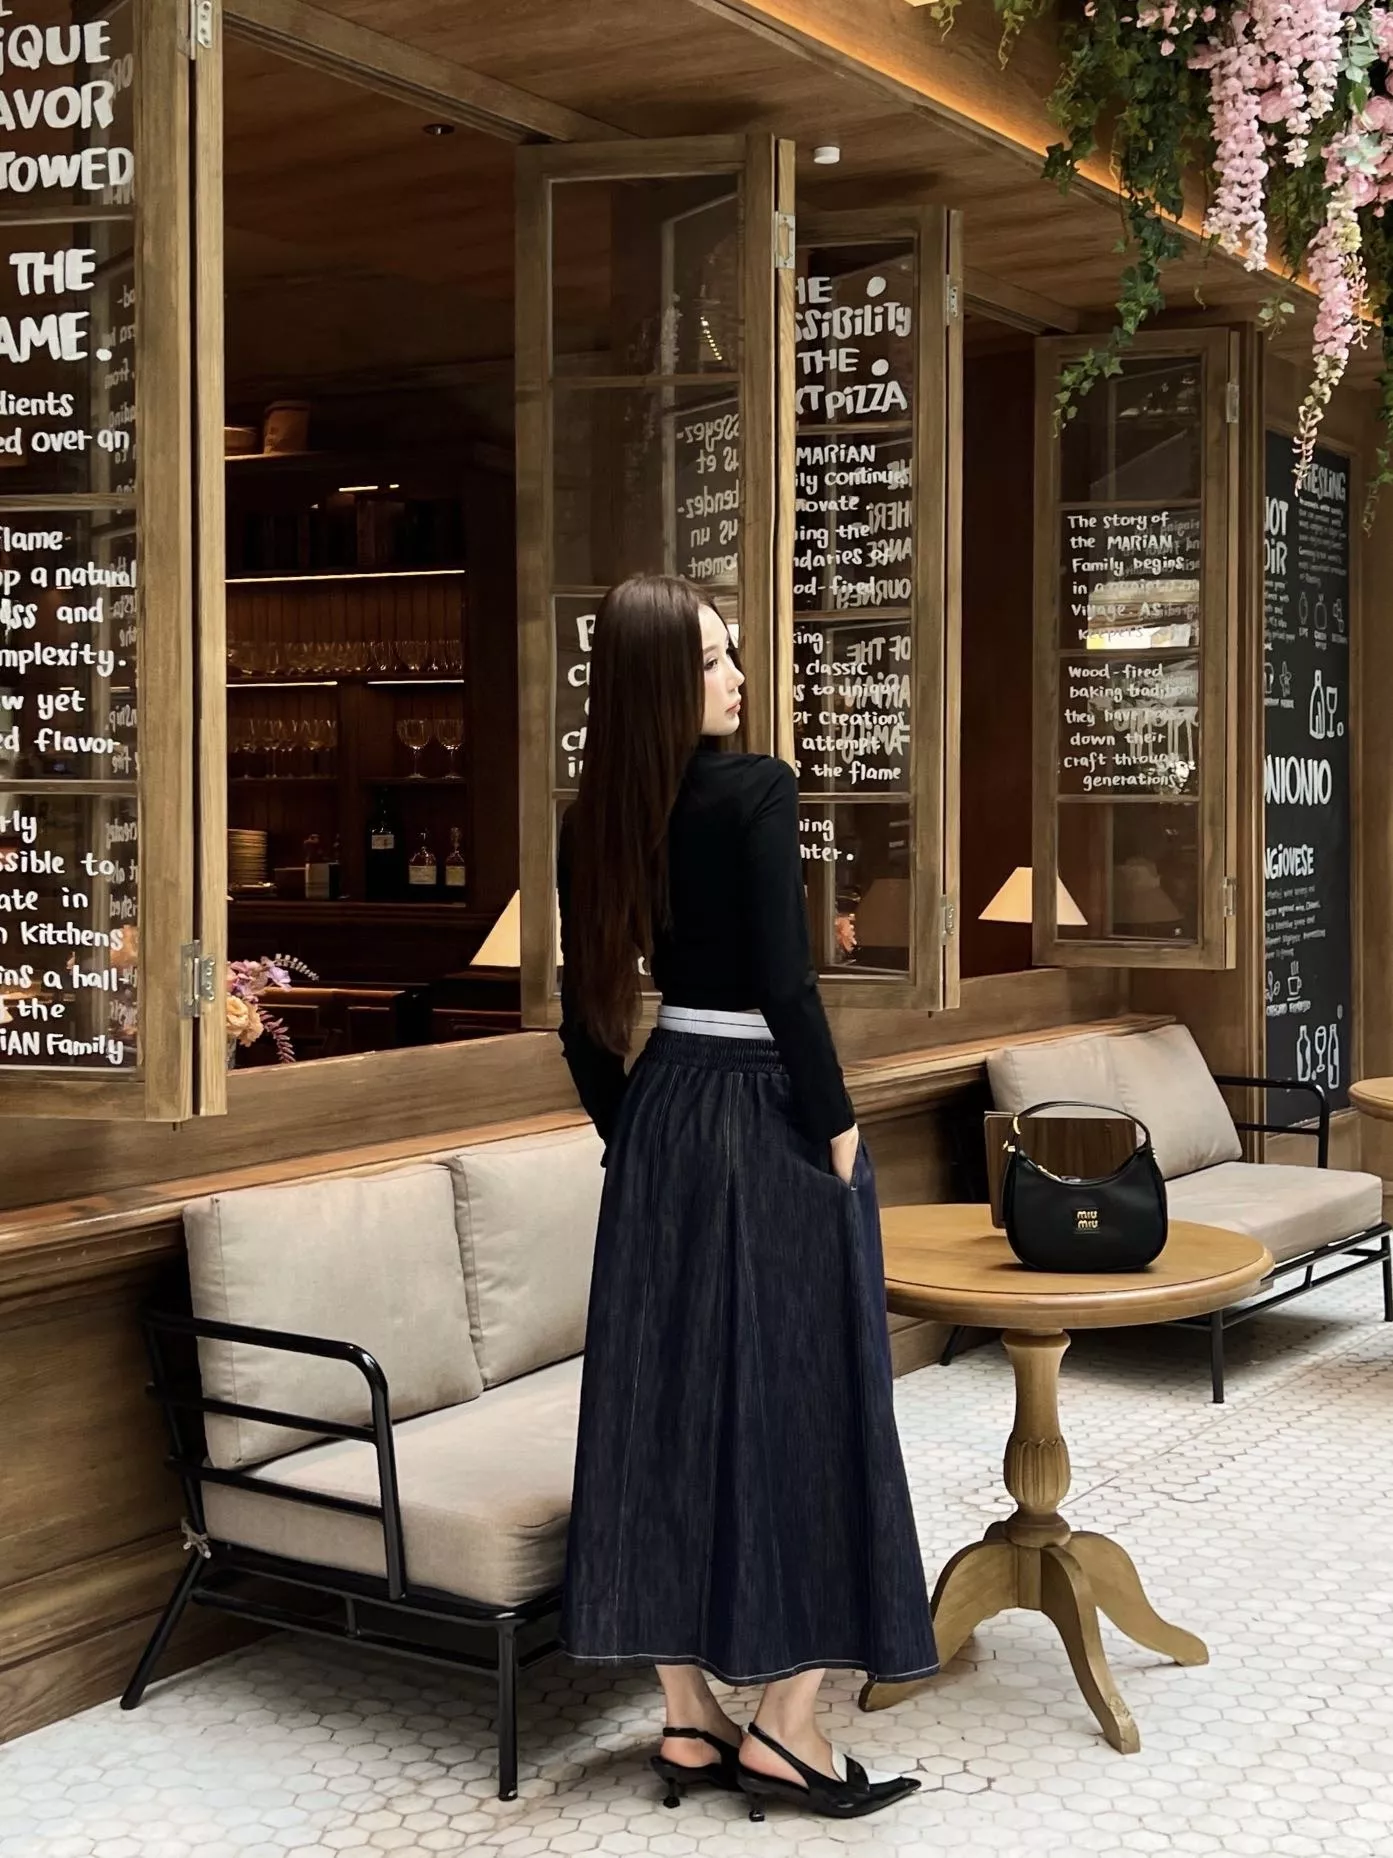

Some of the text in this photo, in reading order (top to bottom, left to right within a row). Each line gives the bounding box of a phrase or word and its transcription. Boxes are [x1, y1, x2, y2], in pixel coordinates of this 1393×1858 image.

[9, 248, 96, 296] THE
[796, 347, 861, 376] THE
[97, 429, 130, 454] an
[1067, 515, 1097, 529] The
[1150, 511, 1170, 527] of
[835, 524, 871, 541] the
[1070, 536, 1096, 549] the
[30, 567, 47, 588] a
[55, 560, 136, 588] natural
[1072, 557, 1124, 577] Family
[1072, 581, 1088, 594] in
[56, 597, 104, 624] and
[806, 659, 868, 676] classic
[812, 683, 836, 696] to
[1069, 685, 1123, 703] baking
[37, 690, 86, 720] yet
[1064, 709, 1096, 727] they
[34, 728, 120, 753] flavor
[1070, 731, 1166, 746] down their
[811, 763, 843, 778] the
[848, 760, 902, 785] flame
[1063, 752, 1107, 773] craft
[80, 852, 115, 876] to
[62, 887, 88, 908] in
[21, 921, 124, 952] kitchens
[43, 970, 63, 989] a
[17, 997, 66, 1021] the
[46, 1033, 124, 1065] Family
